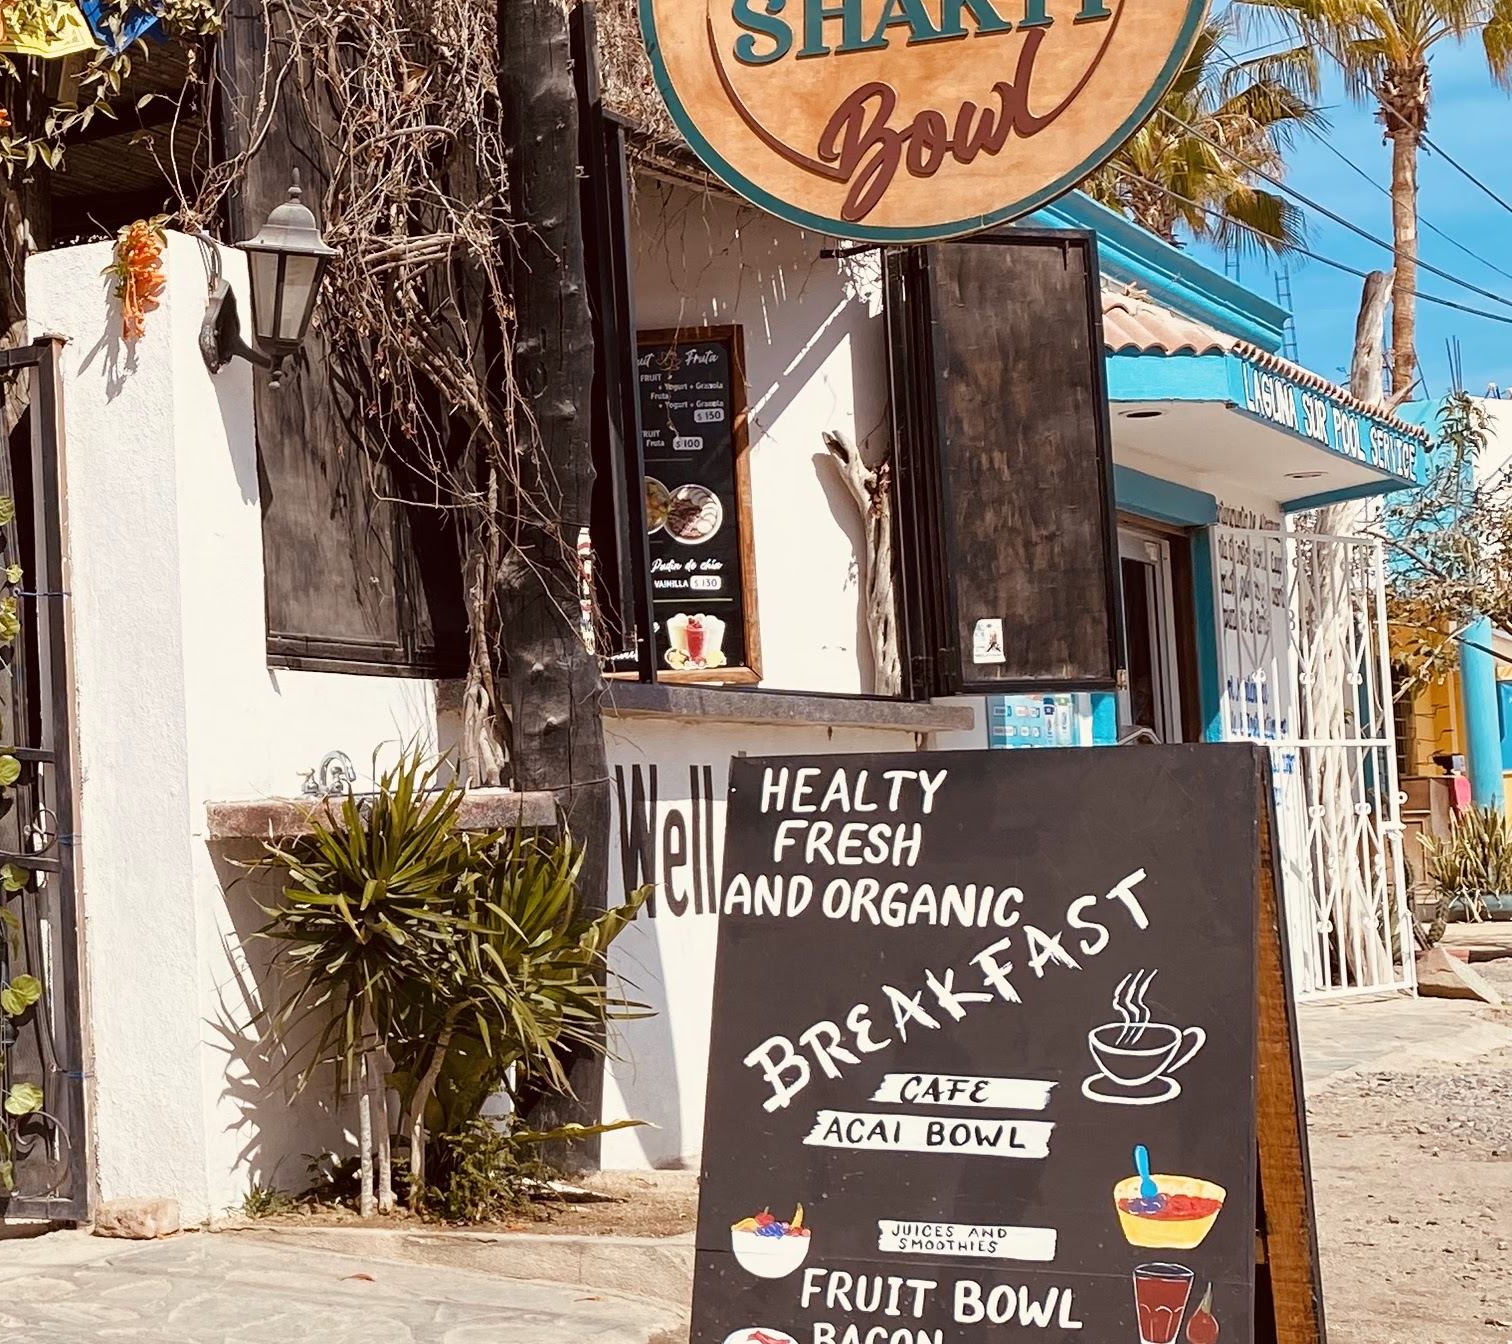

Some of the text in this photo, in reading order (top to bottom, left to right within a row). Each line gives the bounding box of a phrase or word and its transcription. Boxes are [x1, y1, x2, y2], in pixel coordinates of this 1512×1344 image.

[817, 27, 1053, 222] Bowl
[685, 349, 719, 366] Fruta
[1243, 362, 1416, 482] LAGUNA SUR POOL SERVICE
[761, 767, 948, 814] HEALTY
[774, 820, 922, 866] FRESH
[724, 873, 1024, 928] AND ORGANIC
[744, 868, 1149, 1113] BREAKFAST
[900, 1076, 990, 1104] CAFE
[823, 1115, 1027, 1150] ACAI BOWL
[892, 1224, 1007, 1239] JUICES AND
[899, 1237, 998, 1253] SMOOTHIES
[801, 1268, 1083, 1330] FRUIT BOWL
